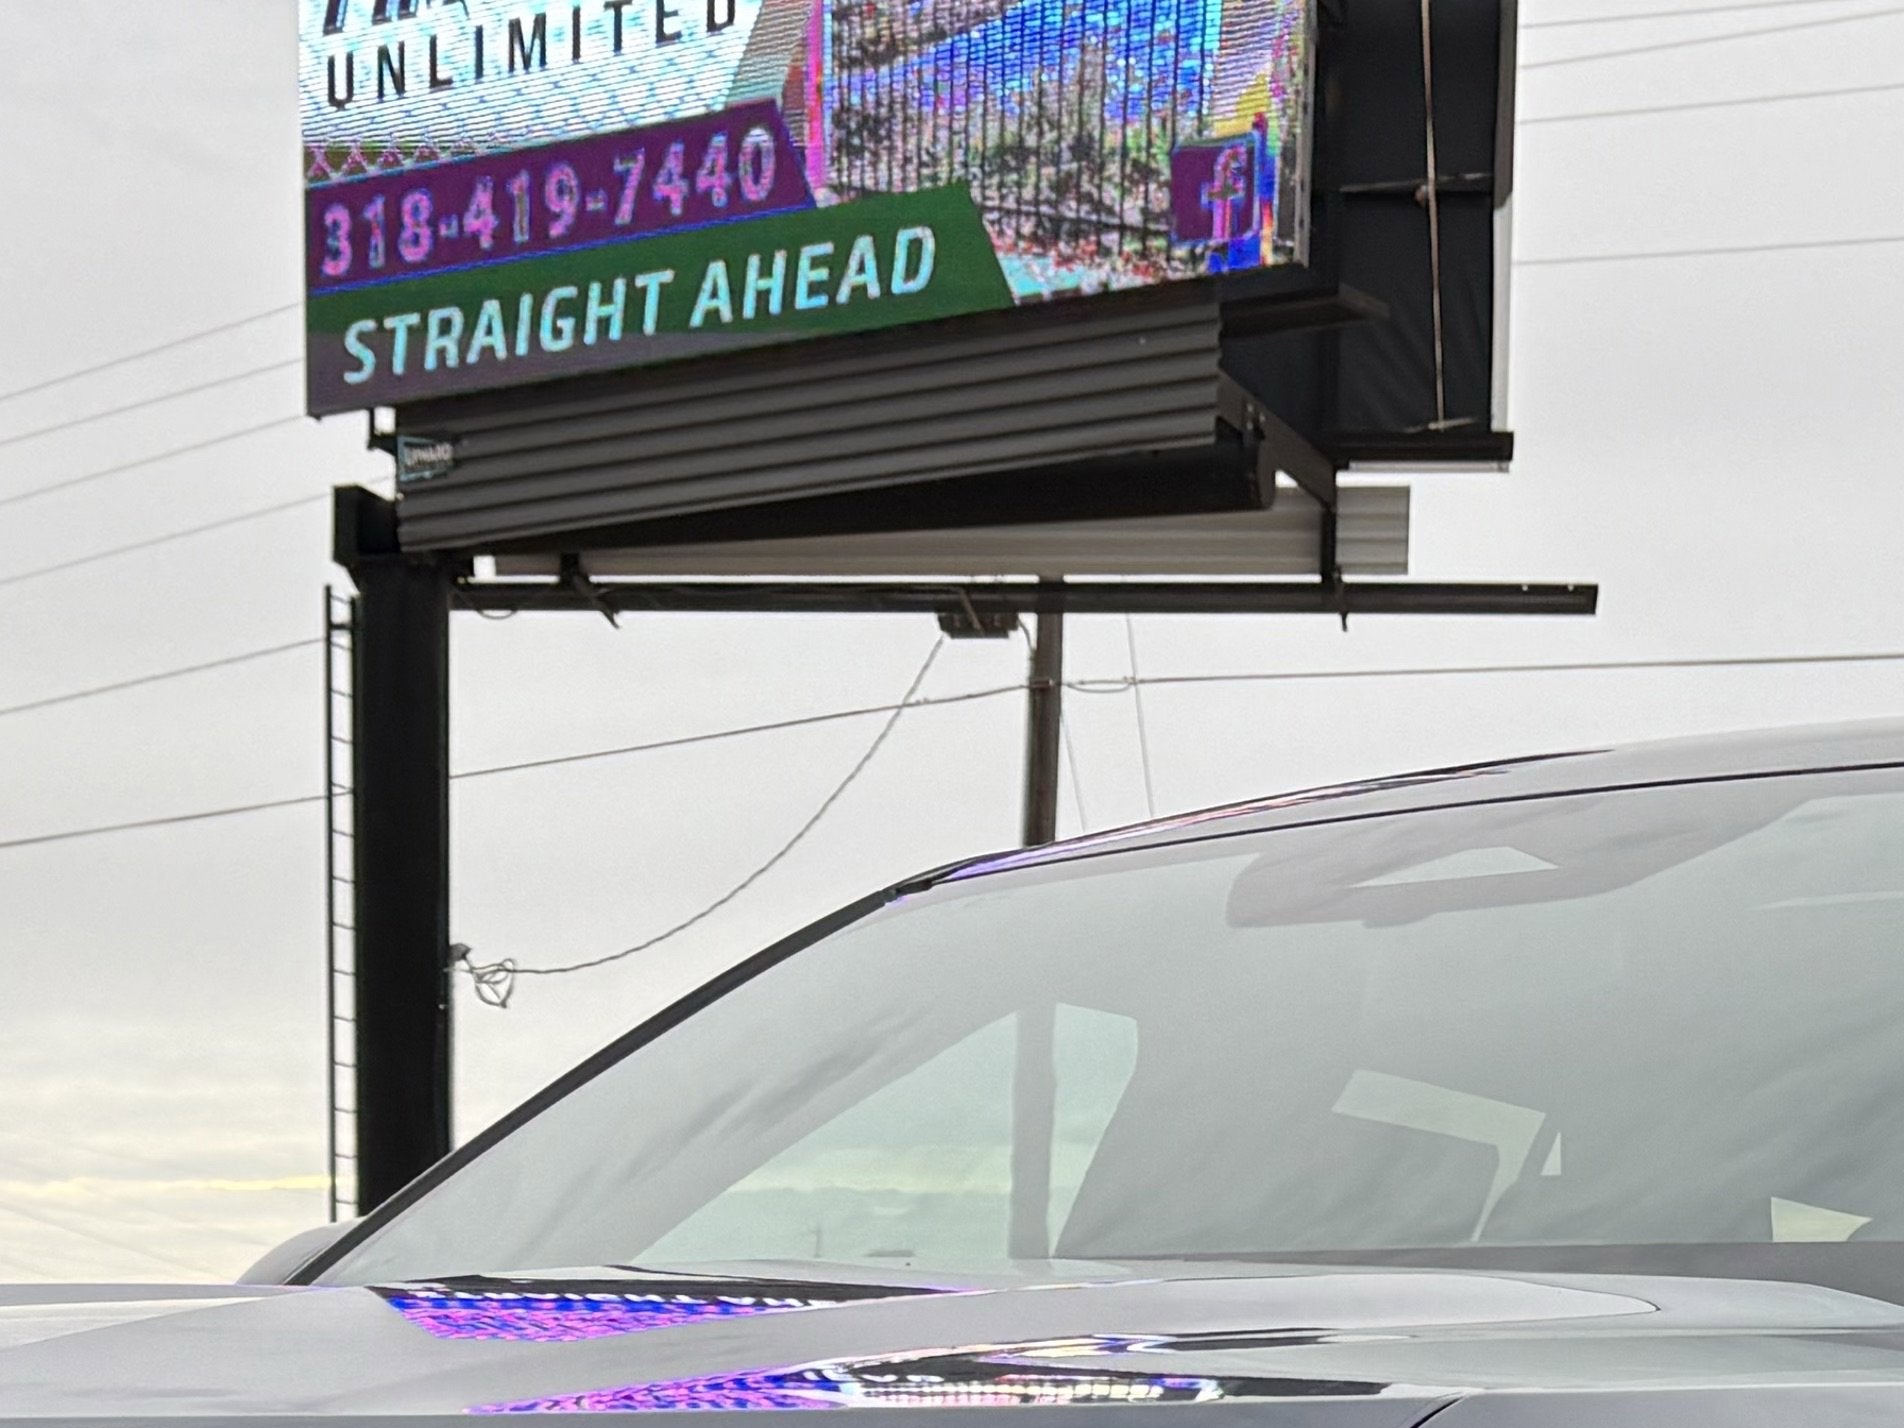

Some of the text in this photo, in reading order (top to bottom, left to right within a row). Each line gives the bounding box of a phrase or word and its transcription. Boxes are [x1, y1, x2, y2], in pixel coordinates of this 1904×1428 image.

[327, 0, 735, 110] UNLIMITED
[320, 126, 776, 278] 318-419-7440
[343, 226, 936, 384] STRAIGHT AHEAD
